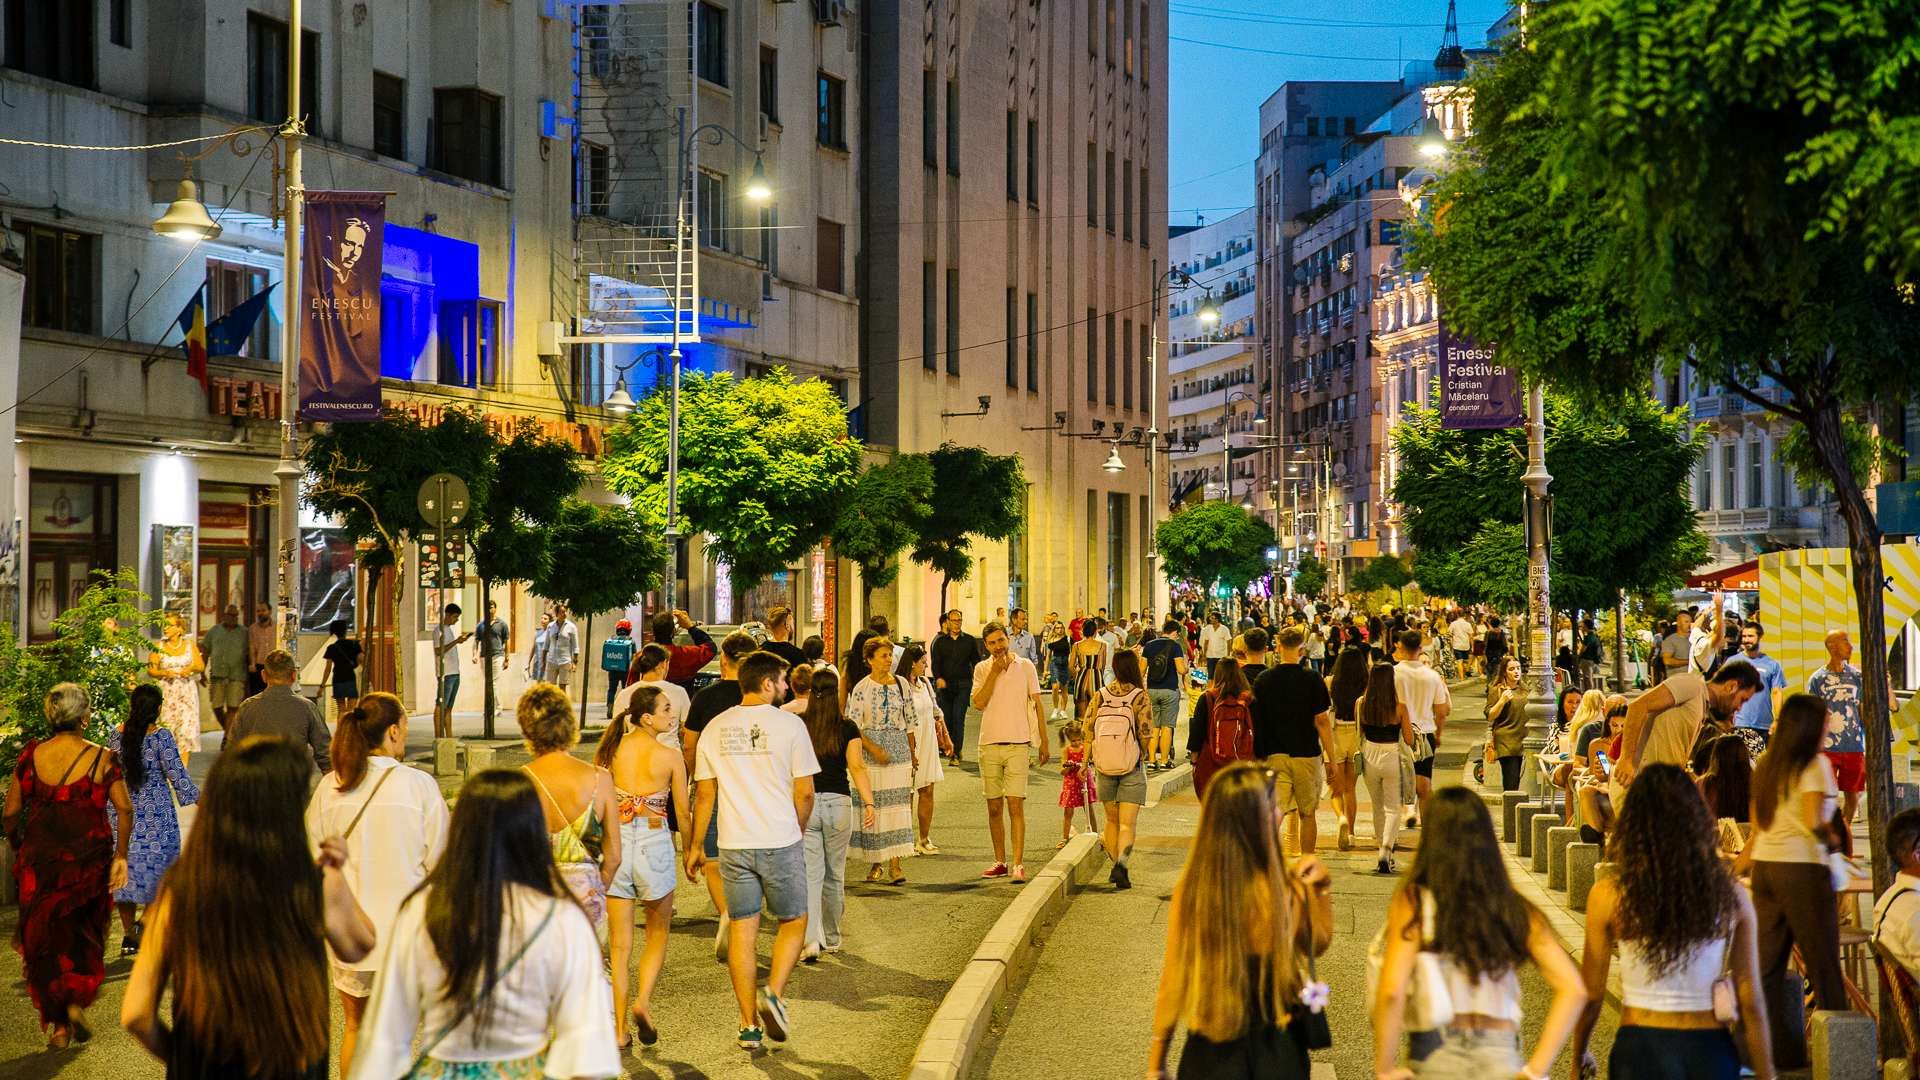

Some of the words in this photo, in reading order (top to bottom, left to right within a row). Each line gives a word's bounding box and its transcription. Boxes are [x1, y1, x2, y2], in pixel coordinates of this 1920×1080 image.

[311, 298, 372, 310] ENESCU
[311, 313, 372, 321] FESTIVAL
[1447, 347, 1496, 361] Enesc
[1448, 381, 1482, 390] Cristian
[308, 402, 374, 410] FESTIVALENESCU.RO
